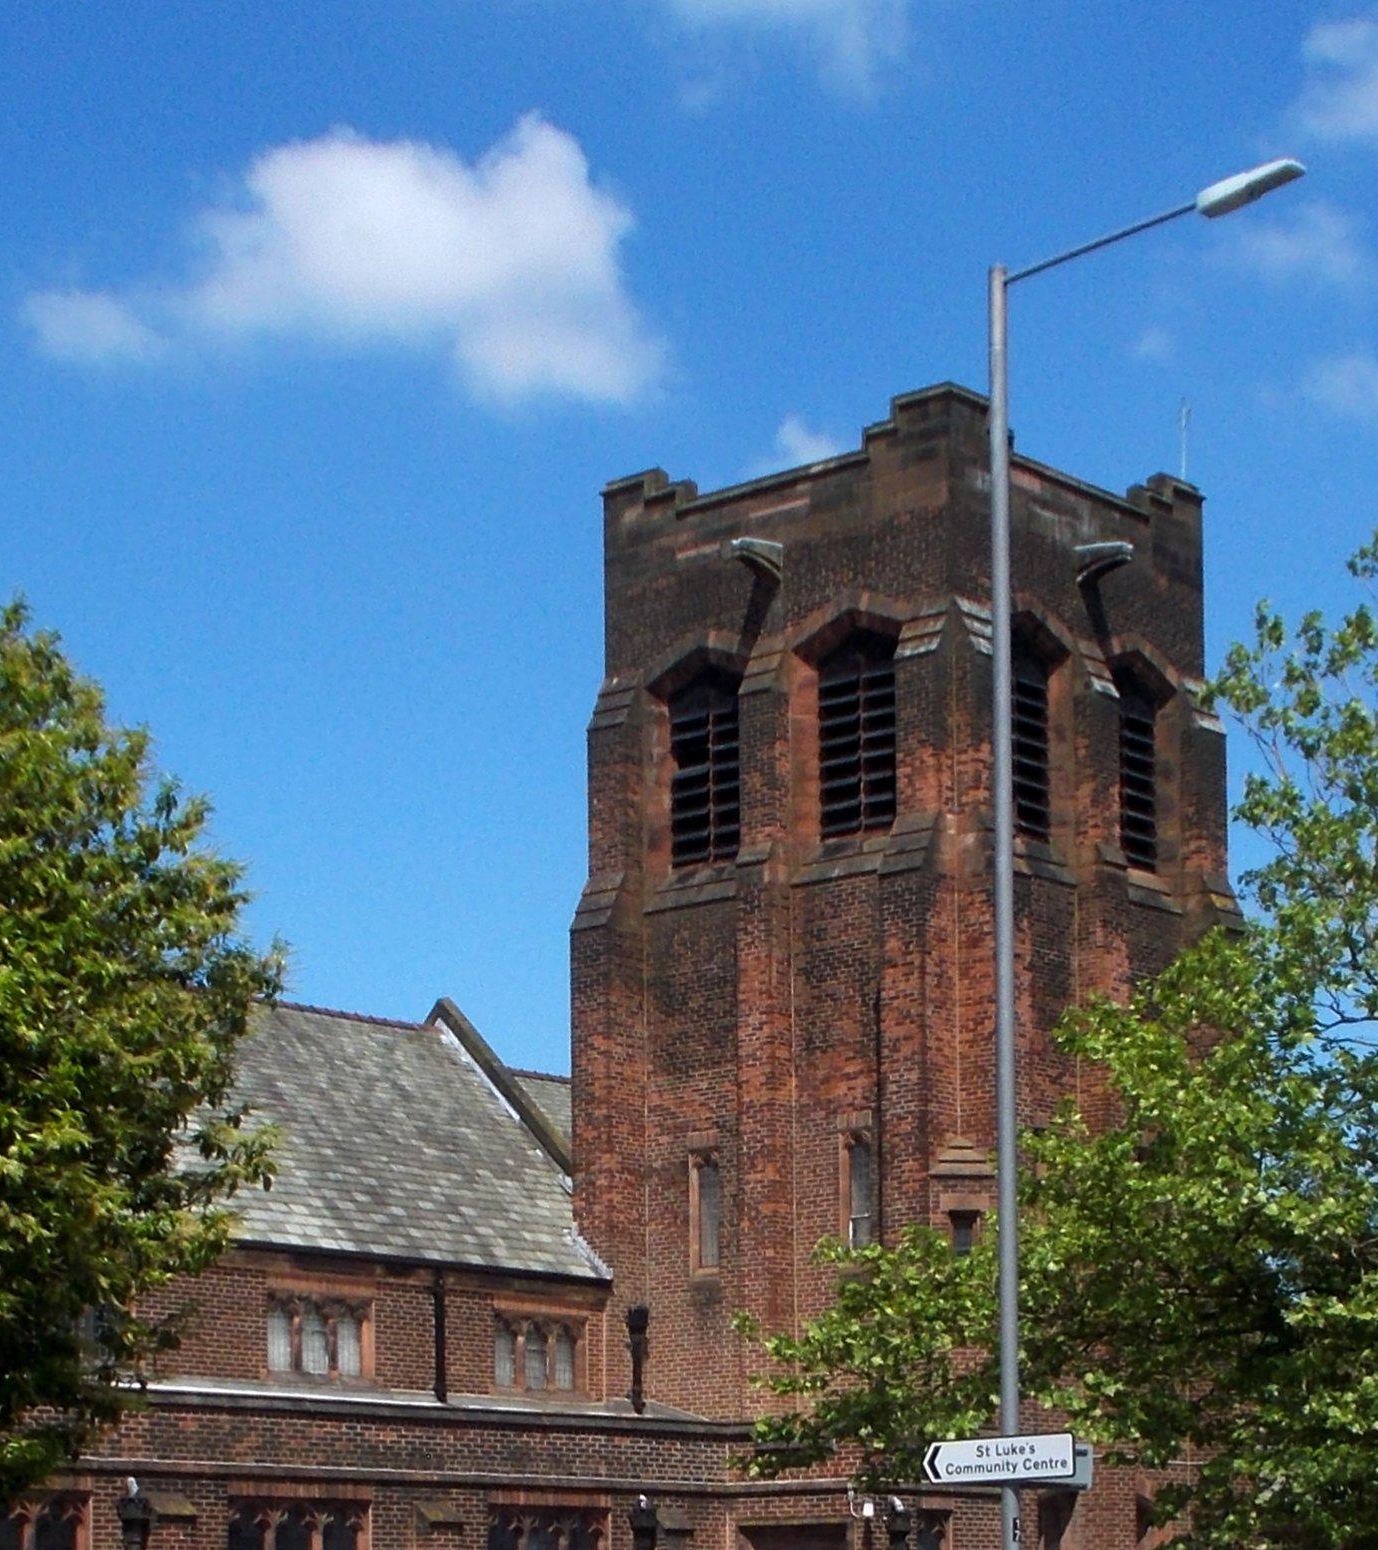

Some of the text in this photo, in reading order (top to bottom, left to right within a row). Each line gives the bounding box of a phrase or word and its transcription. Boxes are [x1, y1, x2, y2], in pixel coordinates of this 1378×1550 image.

[975, 1442, 1036, 1458] St Luke's
[945, 1457, 1068, 1476] Community Centre
